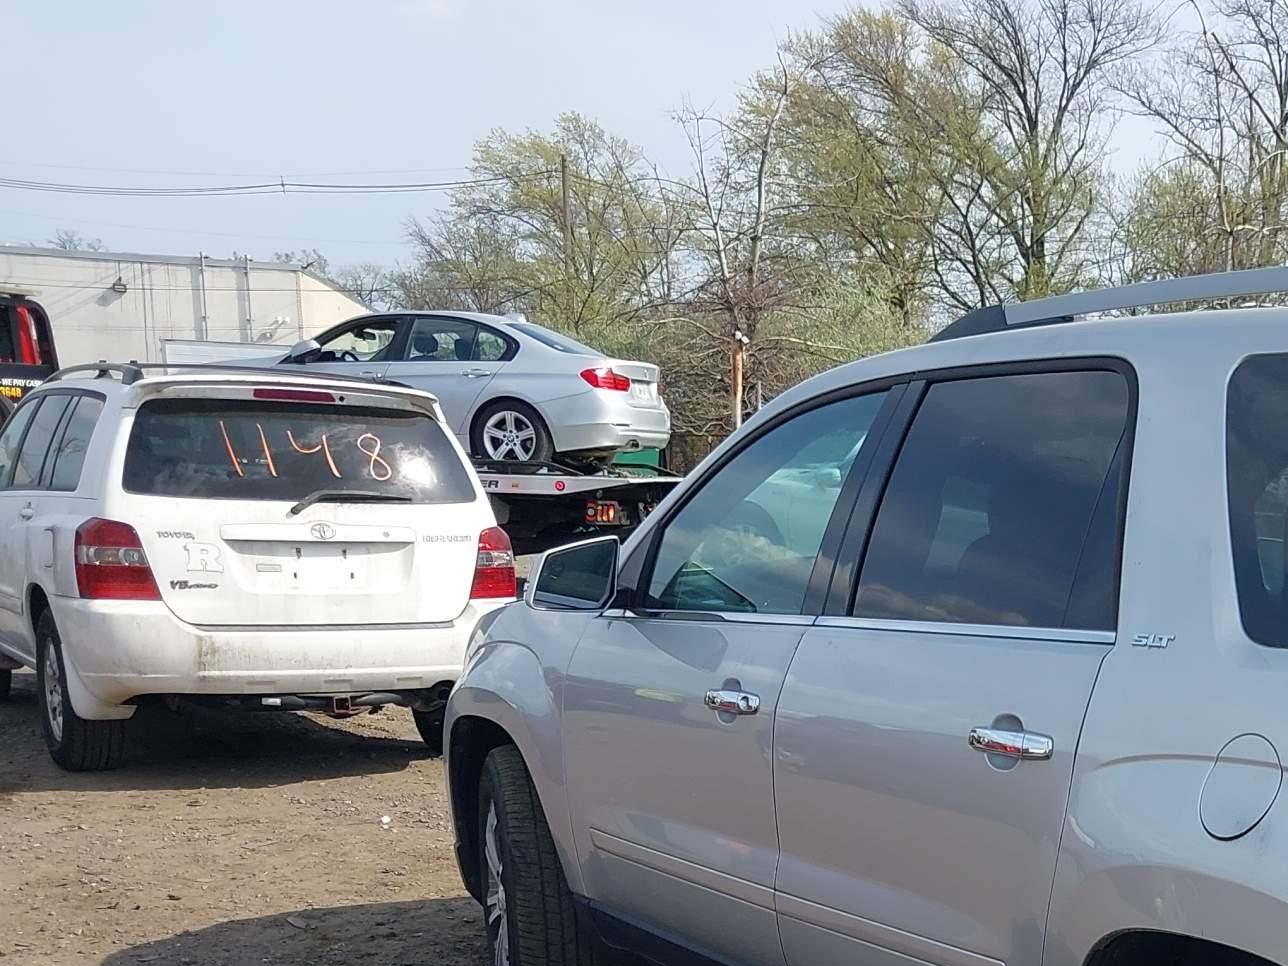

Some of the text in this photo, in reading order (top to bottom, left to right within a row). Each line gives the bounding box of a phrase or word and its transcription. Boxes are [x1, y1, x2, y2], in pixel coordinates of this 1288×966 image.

[219, 420, 392, 481] 1148
[183, 542, 225, 574] R
[1130, 632, 1176, 649] SLT
